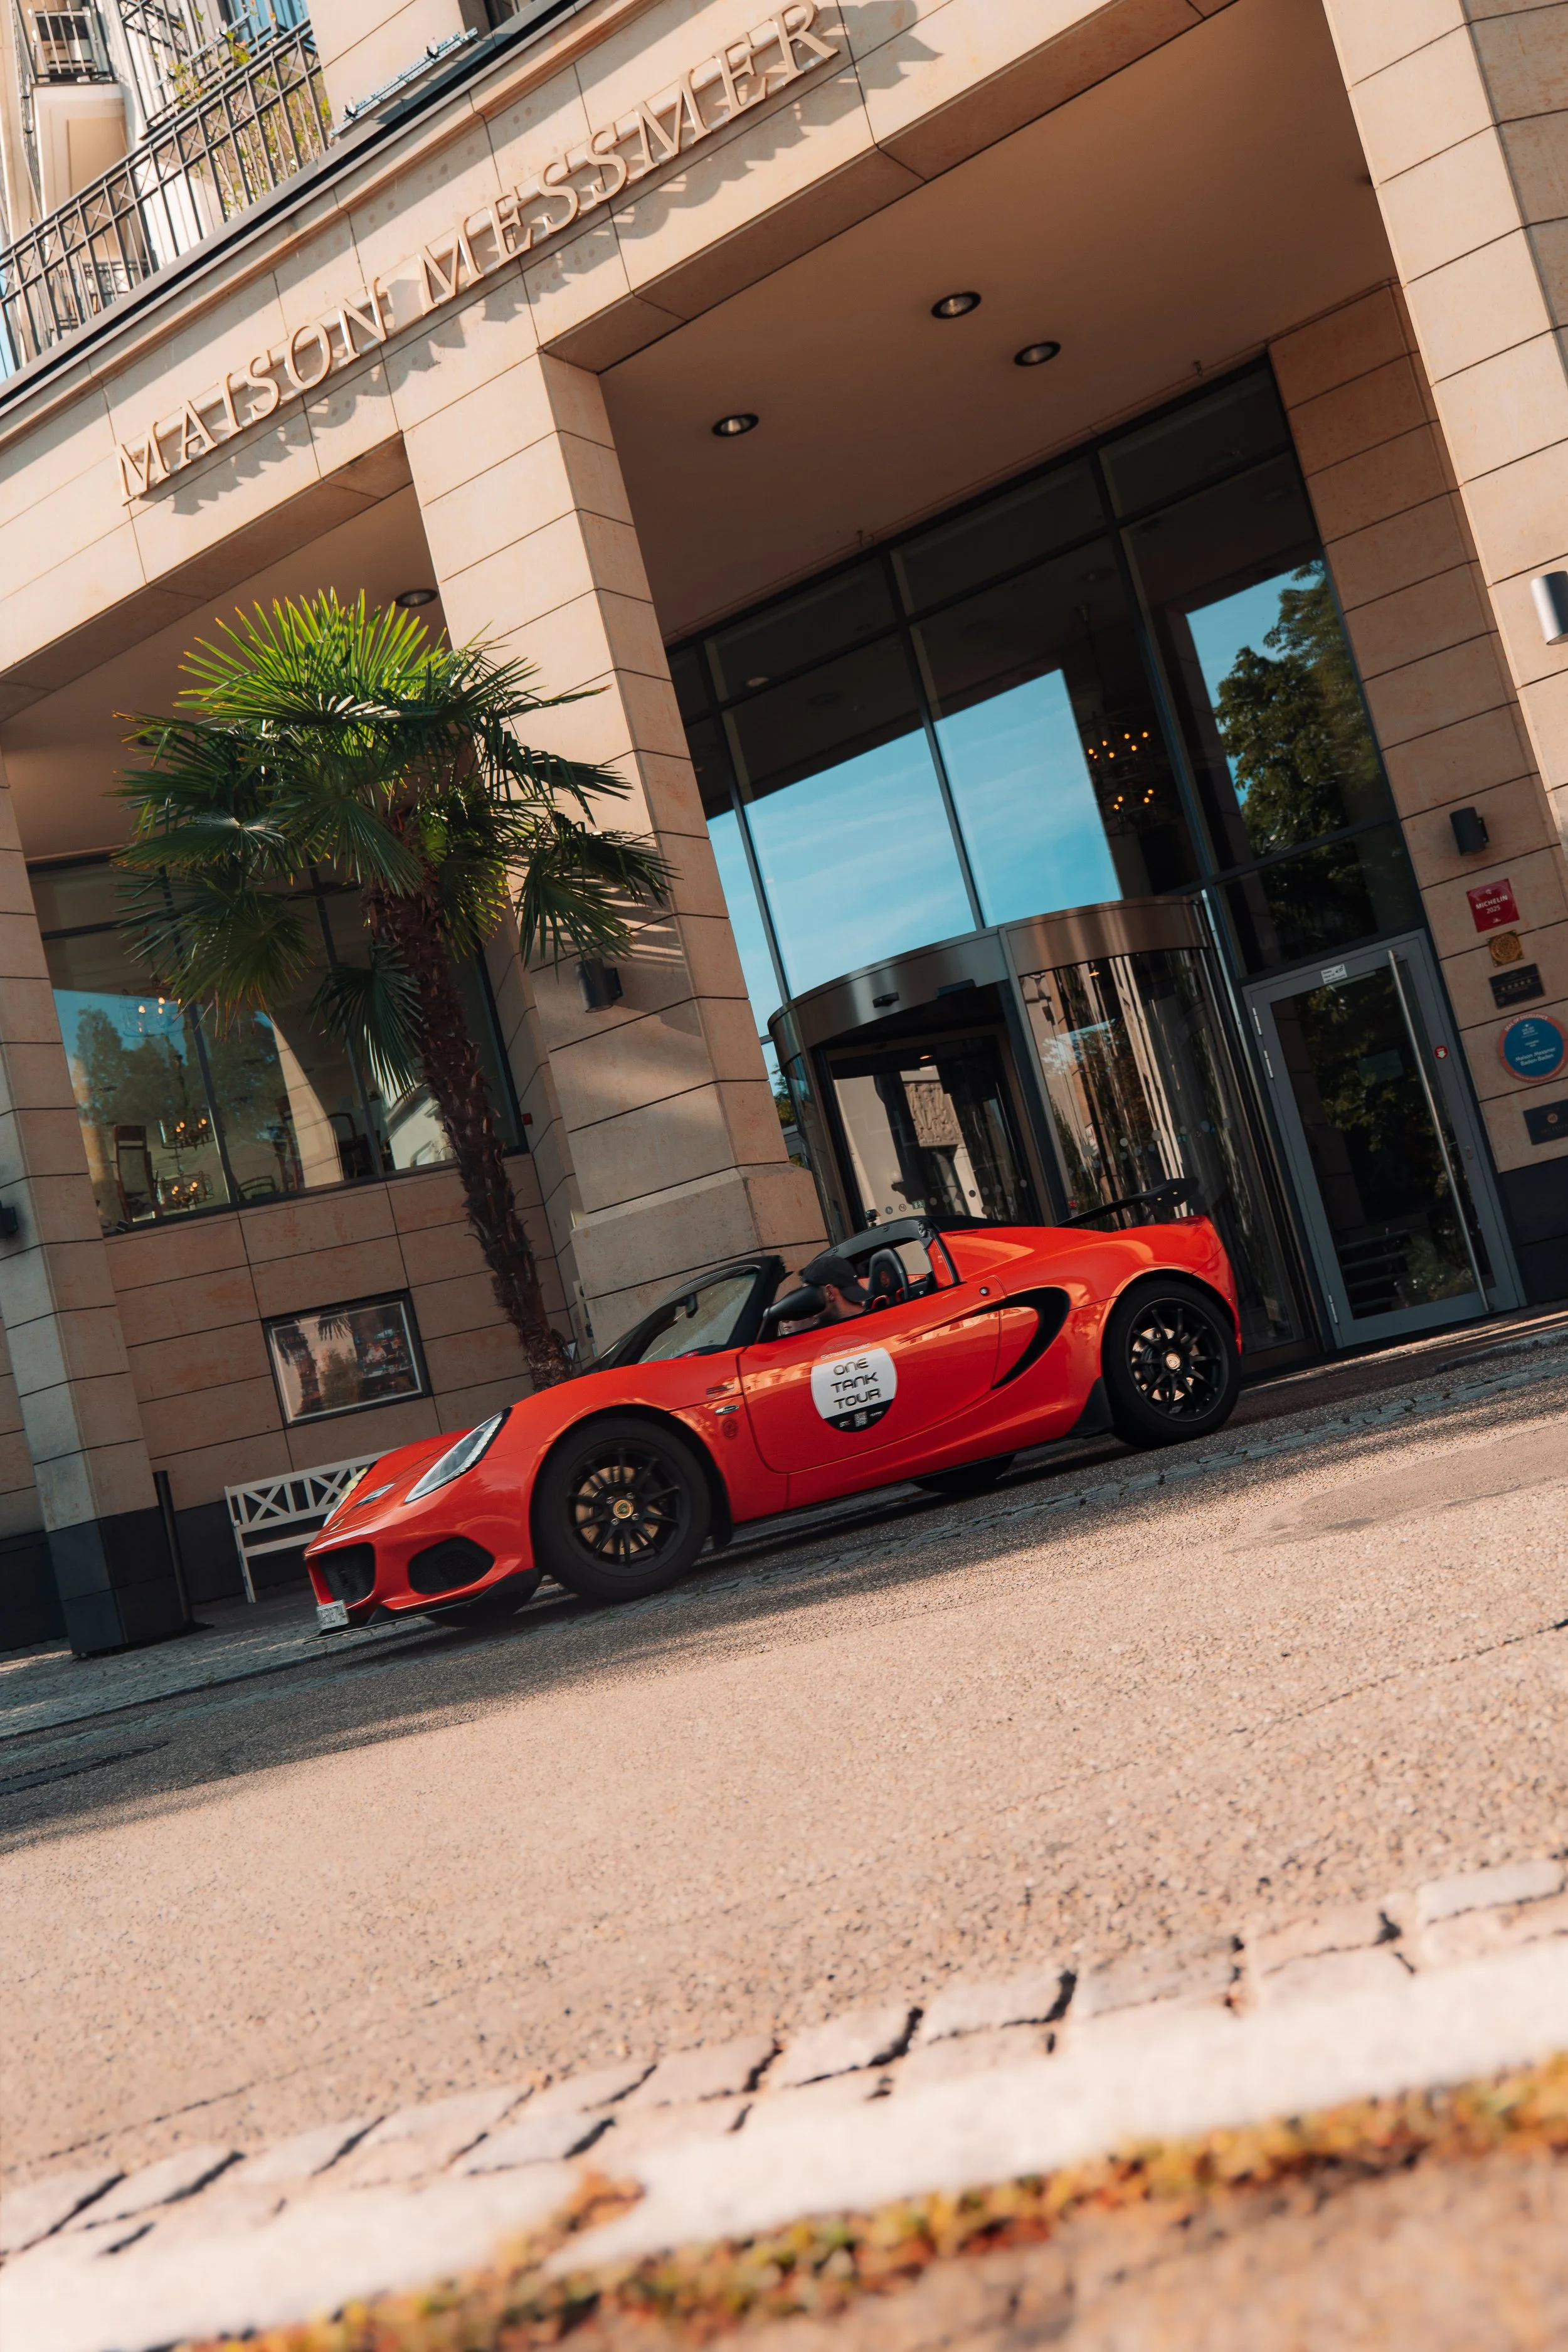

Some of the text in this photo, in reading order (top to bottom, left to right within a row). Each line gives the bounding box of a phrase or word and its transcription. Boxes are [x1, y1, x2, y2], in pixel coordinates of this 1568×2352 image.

[115, 0, 839, 506] MAISON MESSMER
[1476, 895, 1508, 909] MICHELIN
[1486, 905, 1500, 914] 2025
[1505, 1022, 1514, 1032] SEAL
[1520, 1054, 1554, 1066] Baden-Baden
[833, 1358, 869, 1375] ONE
[830, 1372, 879, 1393] TANK
[834, 1388, 882, 1409] TOUR
